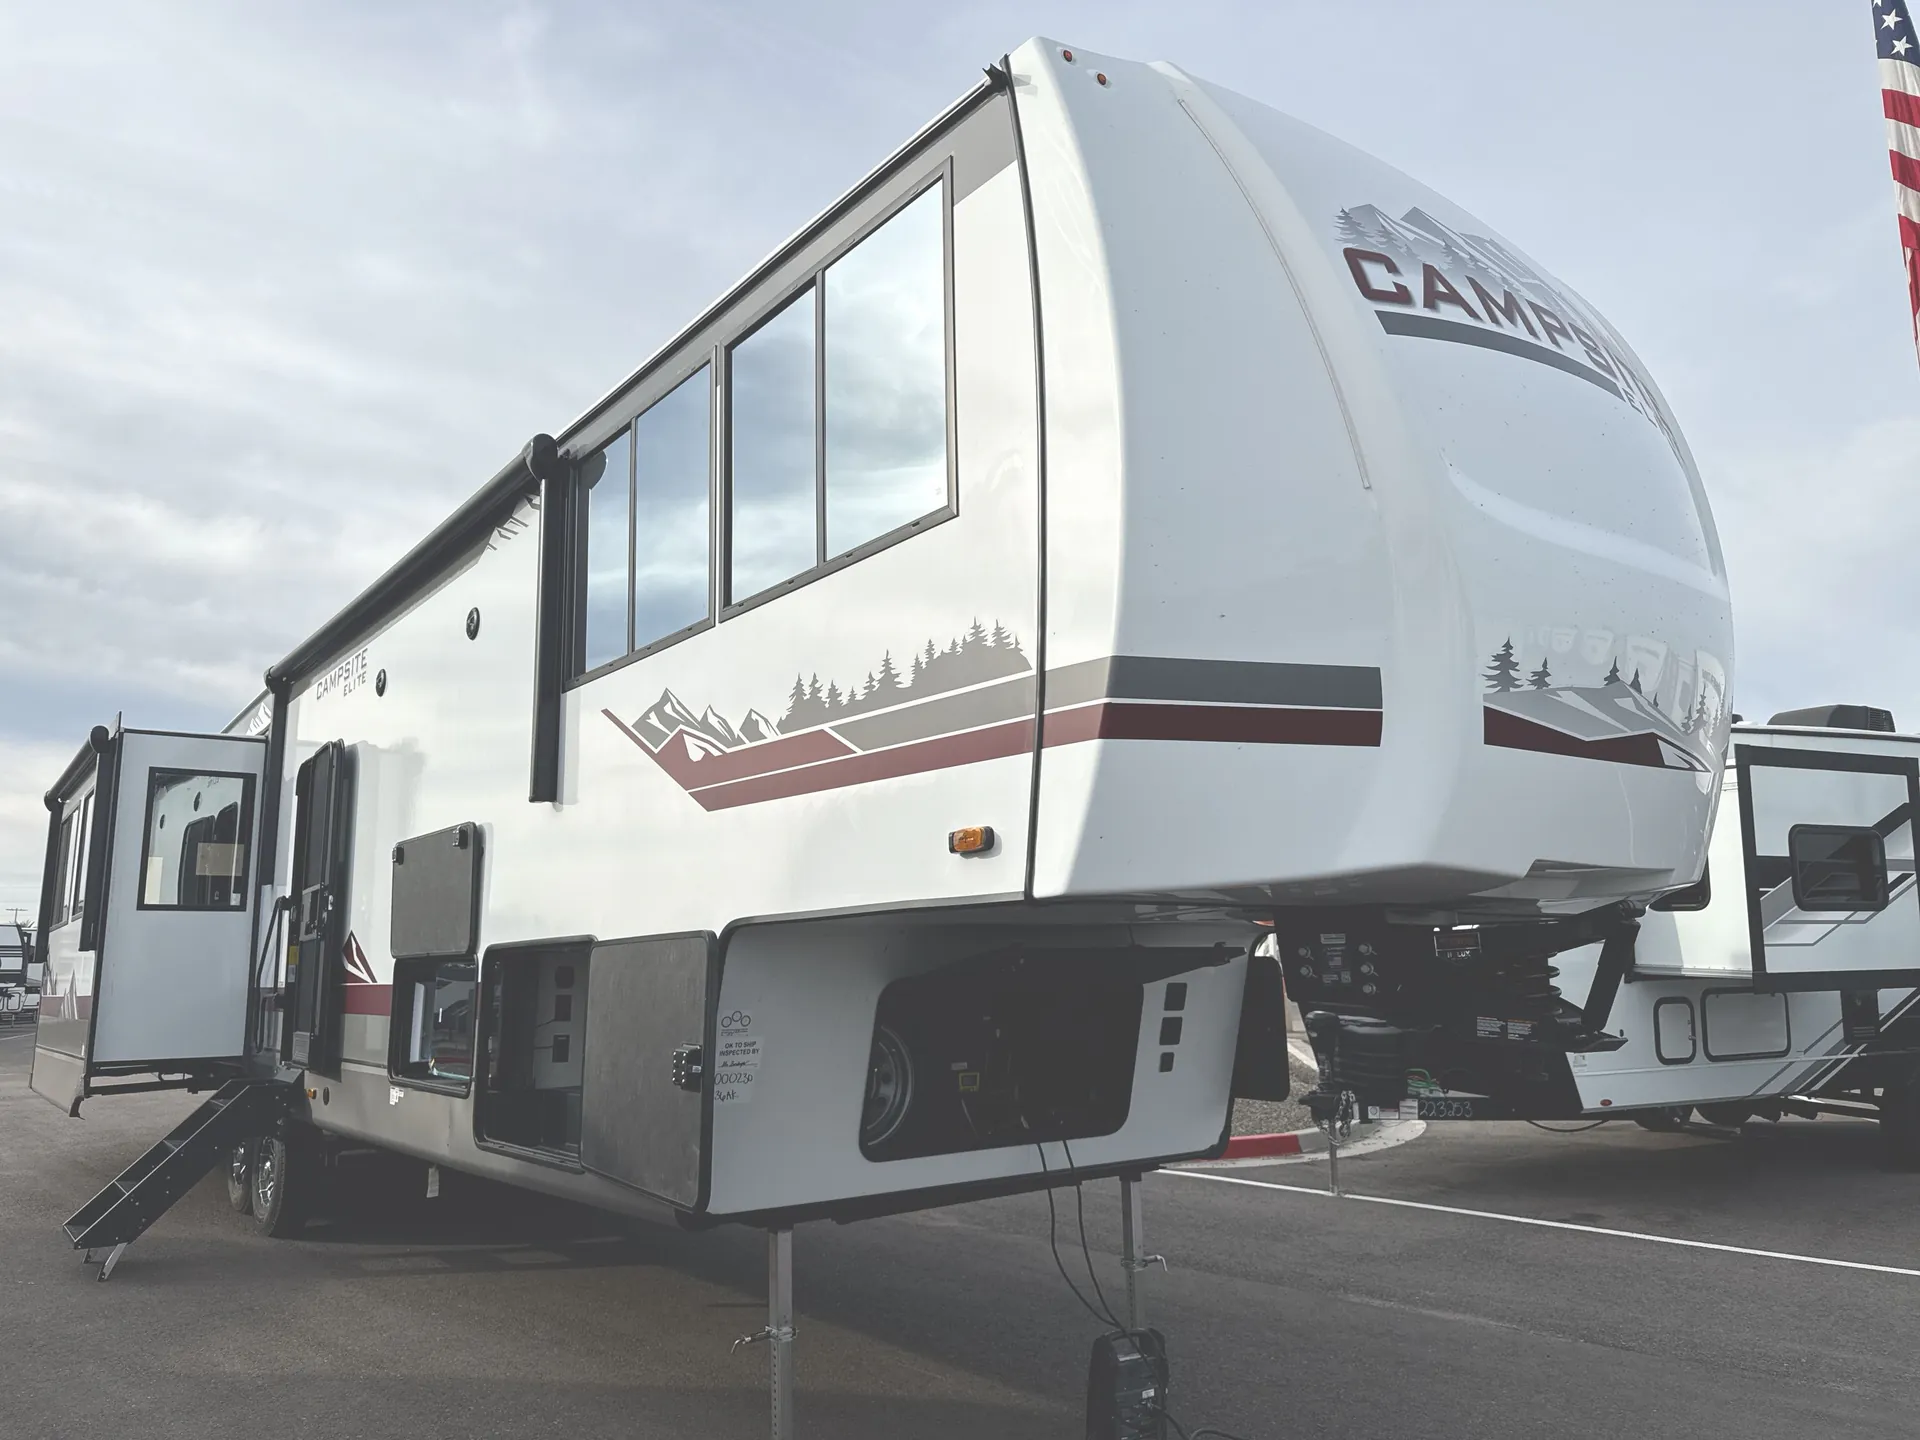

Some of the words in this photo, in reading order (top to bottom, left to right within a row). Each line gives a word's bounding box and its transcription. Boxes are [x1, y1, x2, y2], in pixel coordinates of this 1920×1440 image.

[316, 647, 368, 701] CAMPSITE
[343, 670, 367, 697] ELITE
[719, 1049, 751, 1057] INSPECTED
